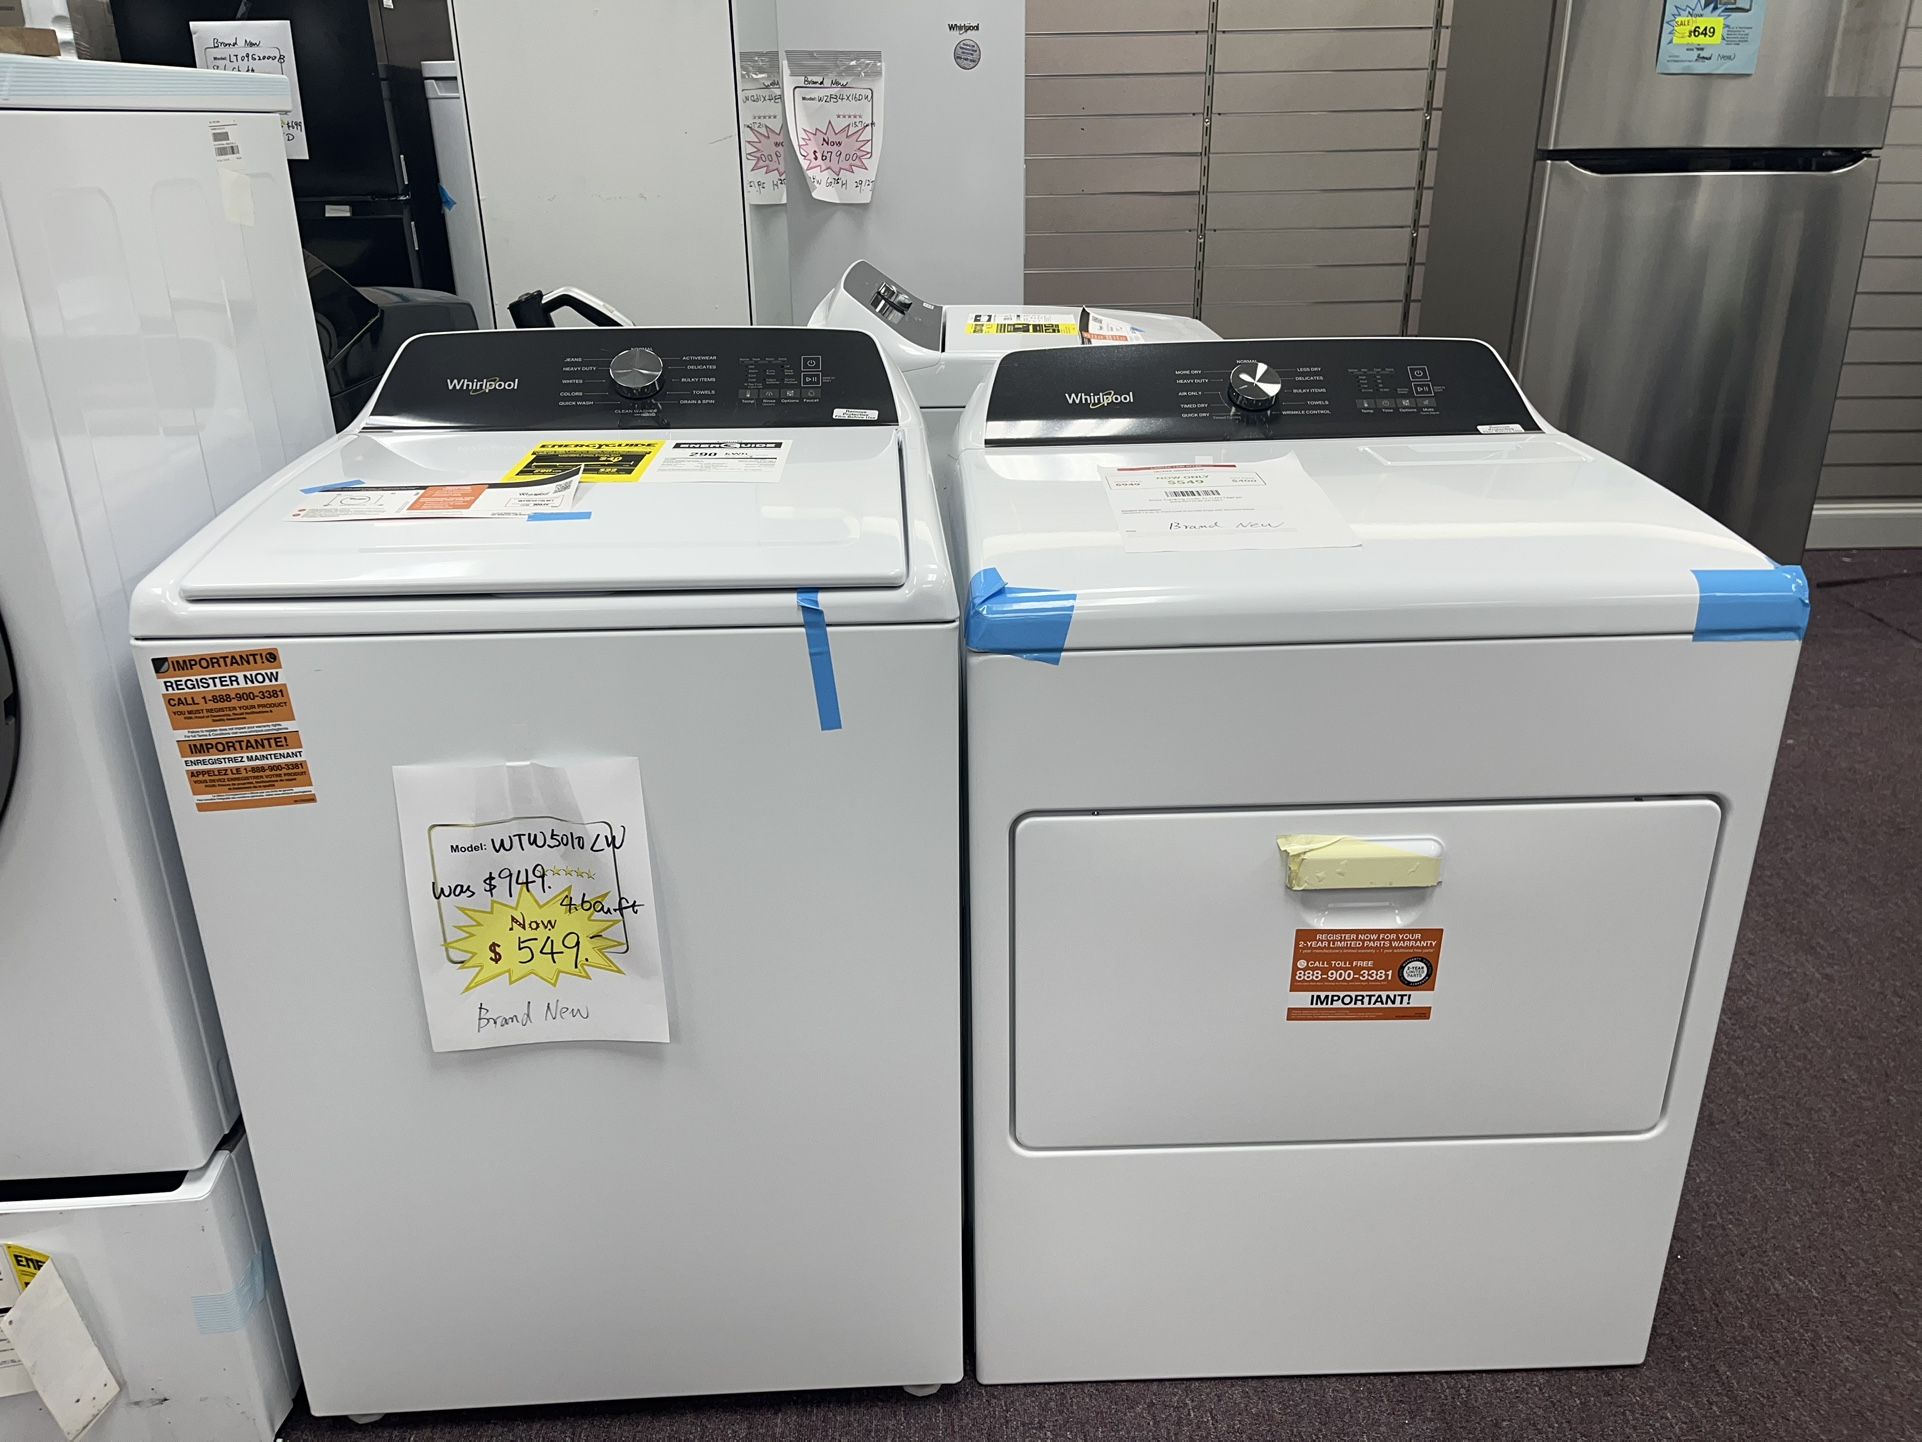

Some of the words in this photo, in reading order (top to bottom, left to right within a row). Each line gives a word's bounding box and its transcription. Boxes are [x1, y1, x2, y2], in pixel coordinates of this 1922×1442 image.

[947, 23, 980, 34] Whirlpool
[1688, 26, 1716, 38] $649
[213, 37, 239, 48] Brand
[244, 39, 261, 47] New
[803, 76, 825, 86] Brand
[821, 137, 843, 147] Now
[447, 377, 519, 394] Whirlpool
[1065, 391, 1134, 408] Whirlpool
[1169, 520, 1223, 531] Brand
[1235, 520, 1285, 529] New
[171, 653, 265, 672] IMPORTANT!
[164, 675, 240, 692] REGISTER
[243, 671, 280, 685] NOW
[168, 697, 200, 707] CALL
[201, 689, 285, 704] 1-888-900-3381
[205, 706, 238, 714] REGISTER
[257, 702, 288, 710] PRODUCT
[188, 736, 289, 755] IMPORTANTE!
[184, 755, 244, 767] ENREGISTREZ
[246, 751, 304, 763] MAINTENANT
[190, 768, 229, 778] APPELEZ
[243, 763, 304, 774] 1-888-900-3381
[450, 843, 488, 853] Model:
[508, 912, 557, 931] Now
[1295, 970, 1393, 981] 888-900-3381
[1310, 994, 1412, 1006] IMPORTANT!
[477, 1001, 532, 1032] Brand
[544, 1000, 589, 1021] New
